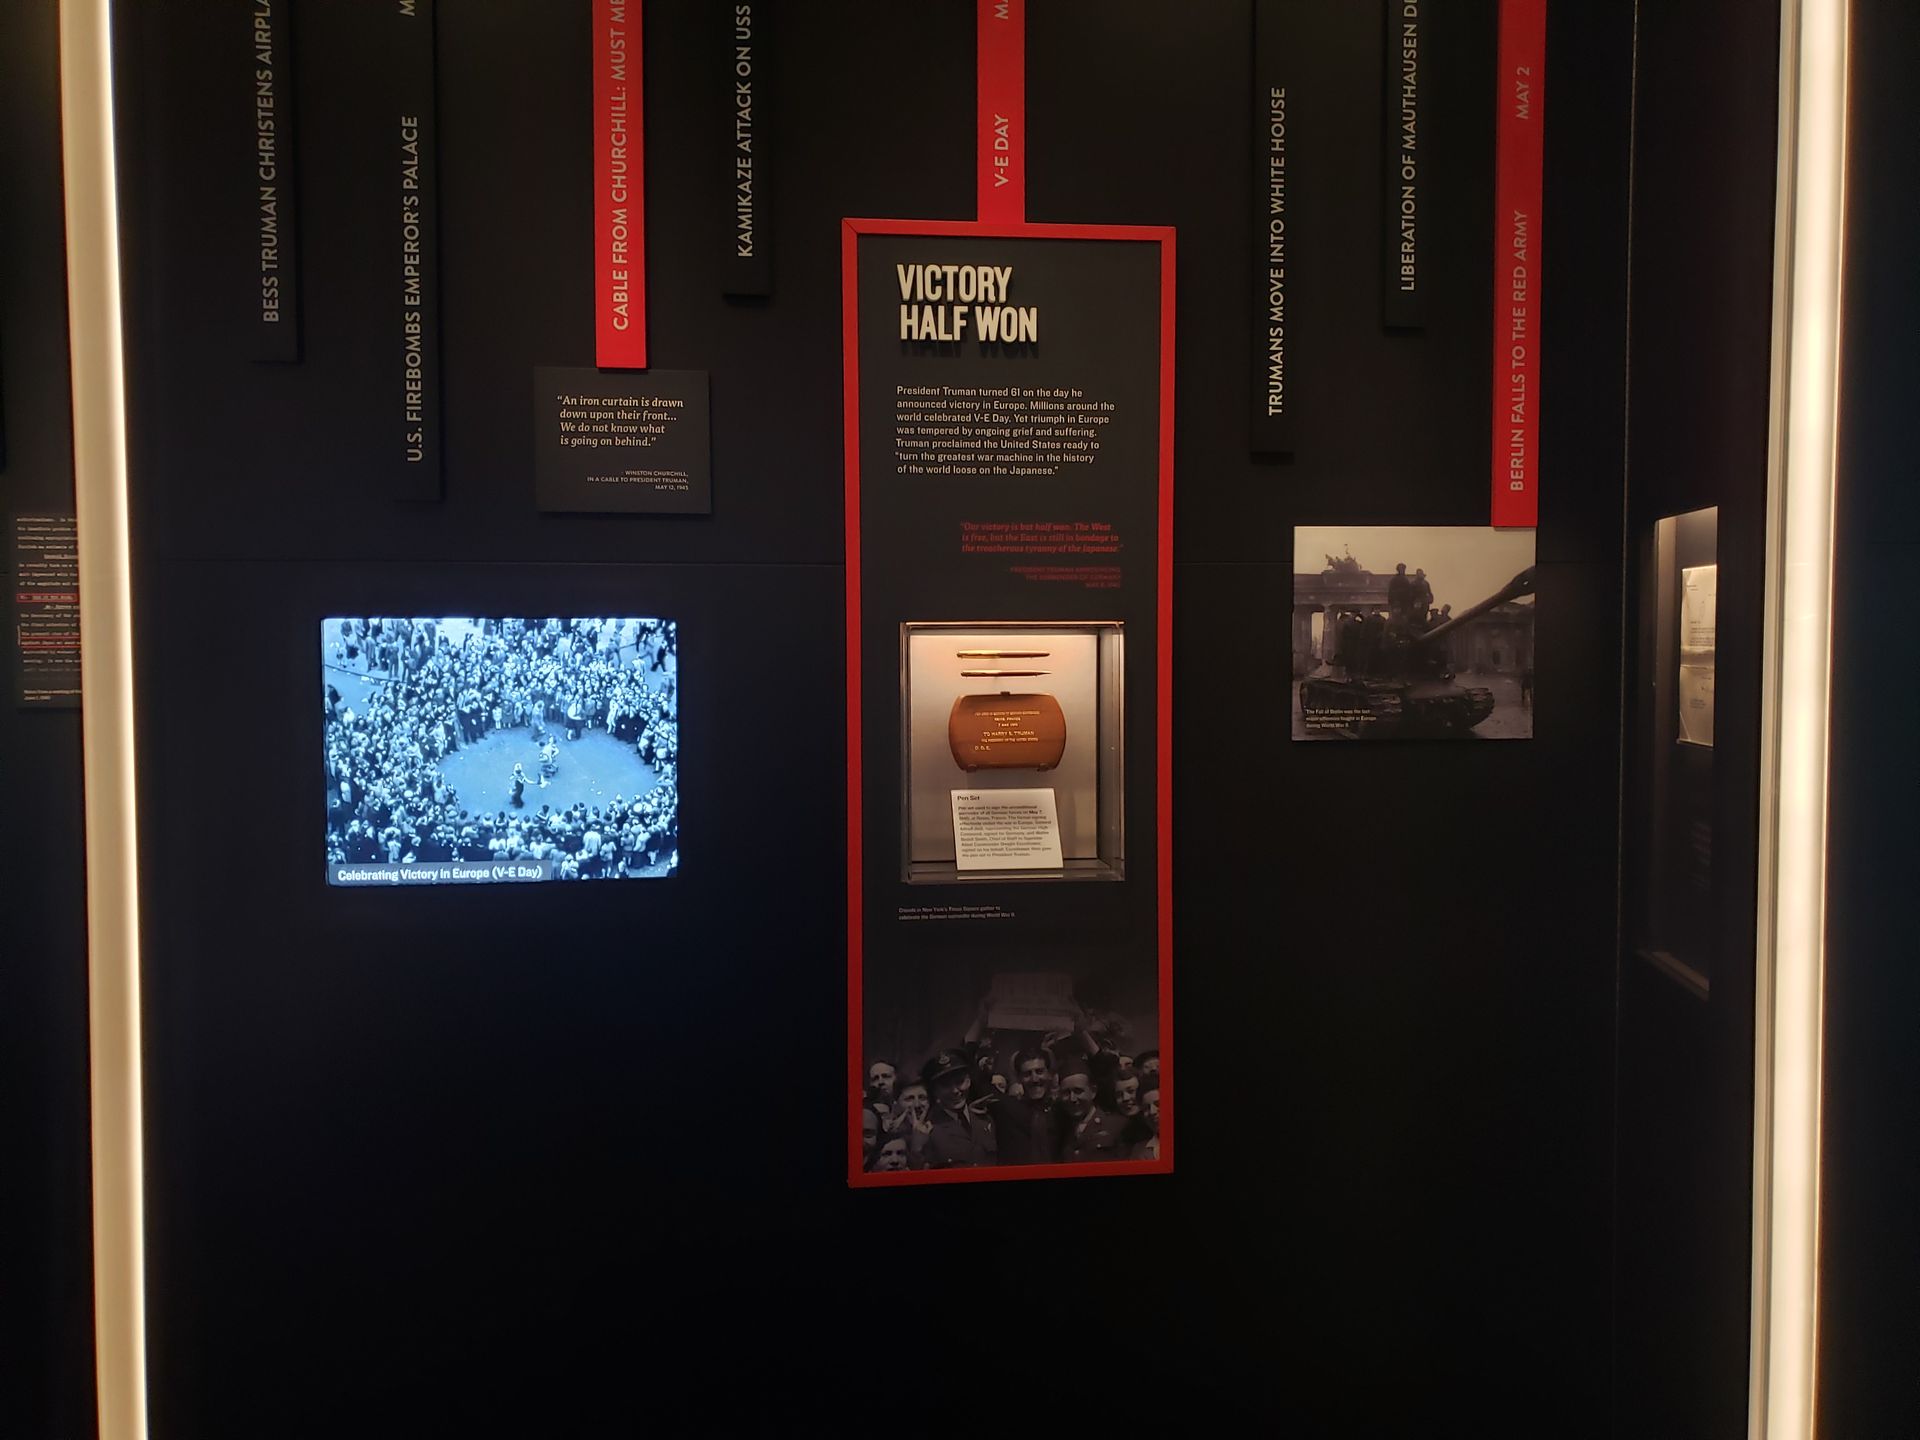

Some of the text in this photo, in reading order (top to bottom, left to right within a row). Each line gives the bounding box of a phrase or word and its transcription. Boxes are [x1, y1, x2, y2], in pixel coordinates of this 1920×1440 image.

[994, 0, 1008, 19] M
[610, 28, 625, 80] MUST
[1402, 23, 1417, 149] MAUTHAUSEN
[1515, 66, 1530, 119] MAY 2
[255, 69, 276, 180] CHRISTENS
[610, 87, 627, 202] CHURCHILL:
[735, 5, 752, 257] KAMIKAZE ATTACK ON USS
[994, 114, 1009, 187] V-E DAY
[1401, 154, 1415, 180] OF
[259, 186, 278, 271] TRUMAN
[611, 208, 627, 264] FROM
[1400, 186, 1415, 290] LIBERATION
[1268, 87, 1285, 416] TRUMANS MOVE INTO WHITE HOUSE
[261, 276, 279, 321] BESS
[401, 116, 422, 461] U.S. FIREBOMBS EMPEROR'S PALACE
[612, 269, 628, 330] CABLE
[896, 263, 1012, 303] VICTORY
[900, 304, 1037, 342] HALF WON
[1509, 210, 1526, 490] BERLIN FALLS TO THE RED ARMY
[579, 395, 599, 405] iron
[601, 396, 638, 406] curtain
[640, 396, 650, 407] is
[651, 397, 683, 407] drawn
[896, 385, 1082, 399] President Truman turned 61 on the day he
[896, 399, 1114, 411] announced victory in Europe. Millions around the
[559, 408, 587, 419] down
[589, 411, 614, 421] upon
[616, 409, 641, 419] their
[560, 421, 665, 433] We do not know what
[896, 412, 1109, 425] world celebrated V-E Day. Yet triumph in Europe
[896, 425, 1097, 438] was tempered by ongoing grief and suffering.
[560, 434, 569, 445] is
[570, 435, 598, 448] going
[894, 451, 918, 460] "turn
[920, 451, 935, 461] the
[937, 452, 974, 462] greatest
[996, 452, 1033, 462] machine
[1035, 453, 1044, 462] in
[1046, 452, 1060, 462] the
[1063, 452, 1094, 464] history
[895, 437, 1099, 451] Truman proclaimed the United States ready to
[897, 464, 906, 473] of
[908, 464, 923, 473] the
[925, 464, 950, 474] world
[952, 464, 977, 474] loose
[992, 465, 1007, 474] the
[1009, 465, 1058, 476] Japanese."
[337, 865, 542, 881] Celebrating Victory in Europe (V-E Day)
